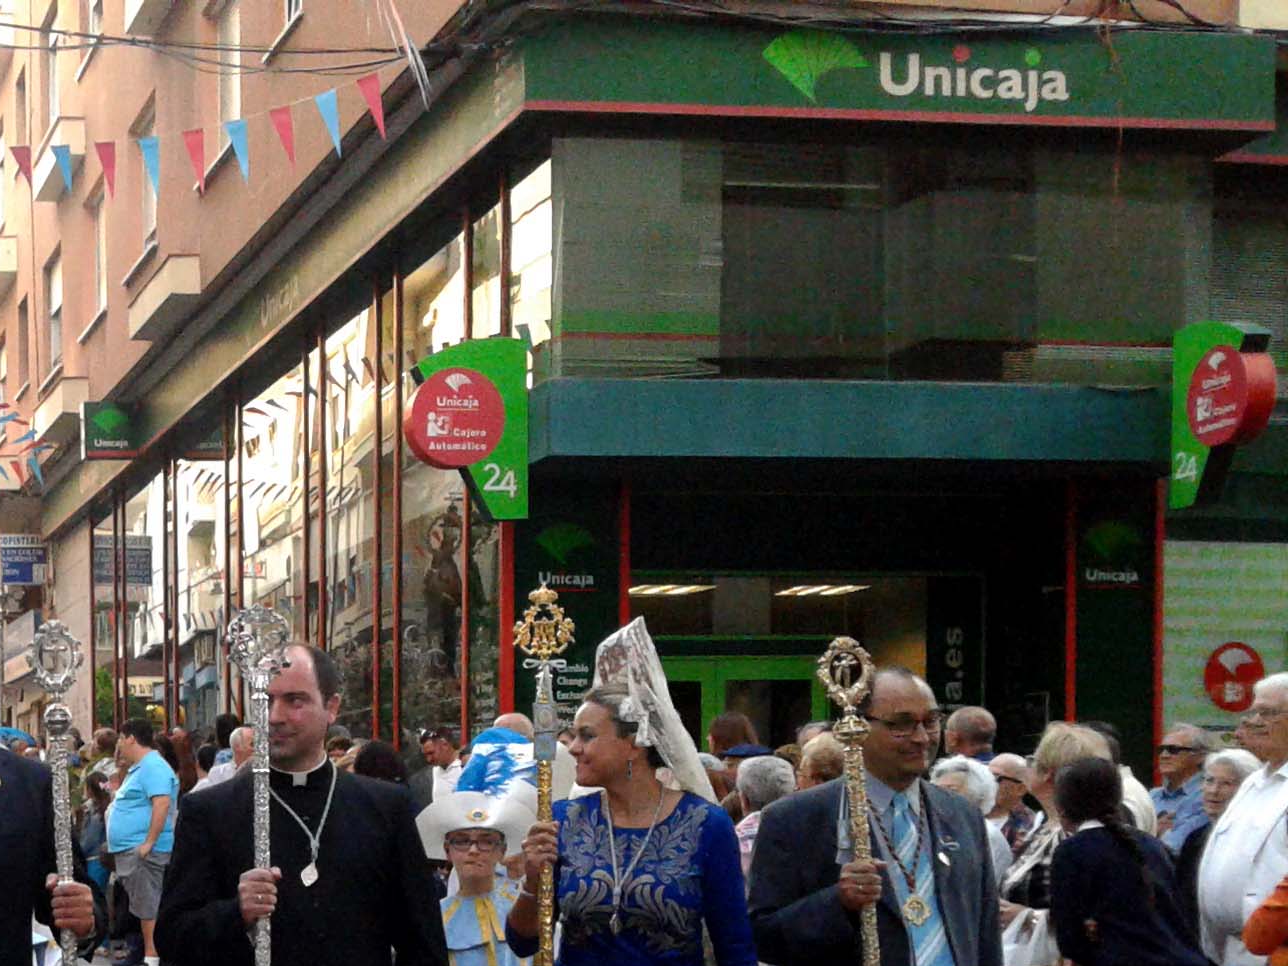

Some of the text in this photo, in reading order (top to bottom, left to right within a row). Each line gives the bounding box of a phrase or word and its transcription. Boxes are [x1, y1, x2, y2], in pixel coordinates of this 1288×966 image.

[879, 44, 1070, 112] Unicaja
[436, 396, 480, 409] Unicaja
[453, 428, 487, 439] Cajero
[94, 437, 129, 449] Unicaja
[1174, 451, 1198, 482] 24
[483, 463, 518, 498] 24
[538, 571, 594, 588] Unicaja
[1085, 567, 1139, 583] Unicaja
